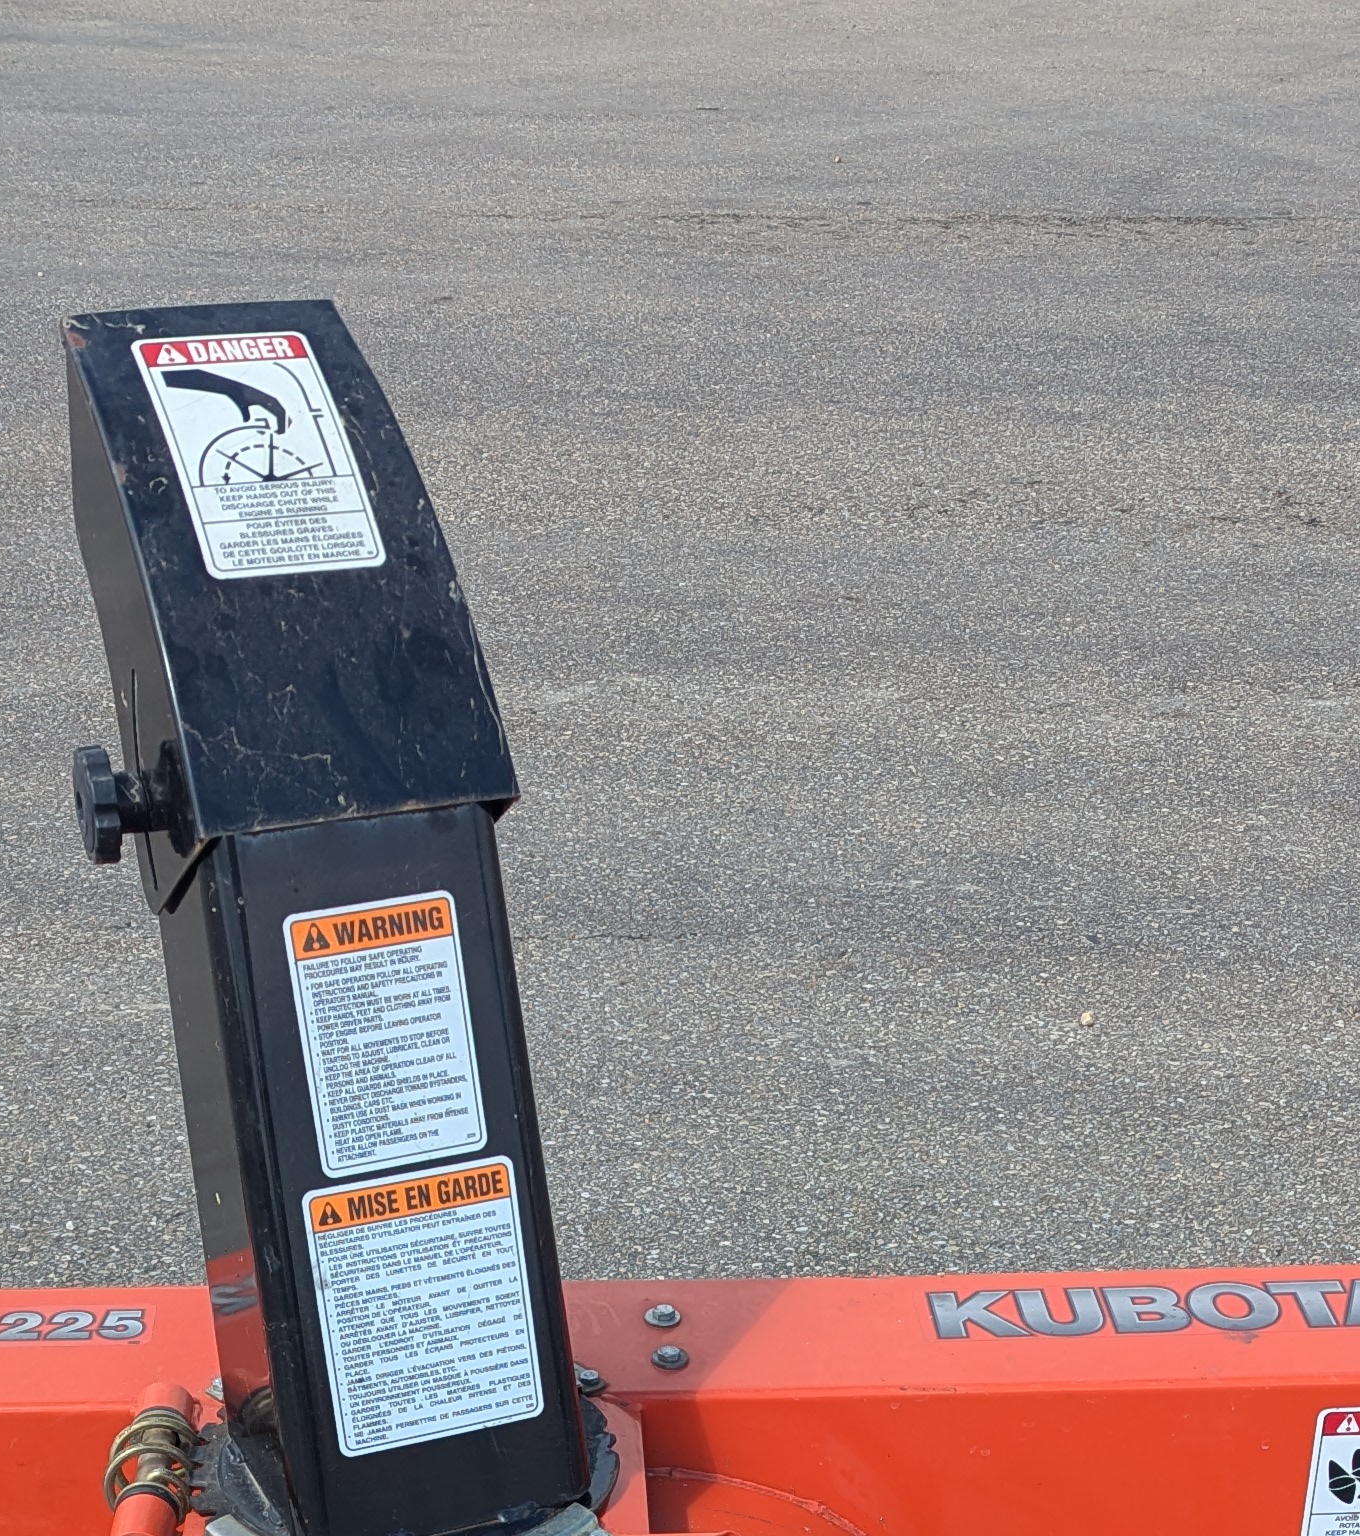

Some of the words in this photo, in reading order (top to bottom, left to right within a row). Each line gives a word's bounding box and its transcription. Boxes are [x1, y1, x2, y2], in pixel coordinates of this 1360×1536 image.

[186, 337, 295, 363] DANGER
[332, 906, 444, 948] WARNING
[347, 1189, 400, 1222] MISE
[405, 1183, 432, 1210] EN
[437, 1169, 504, 1203] GARDE
